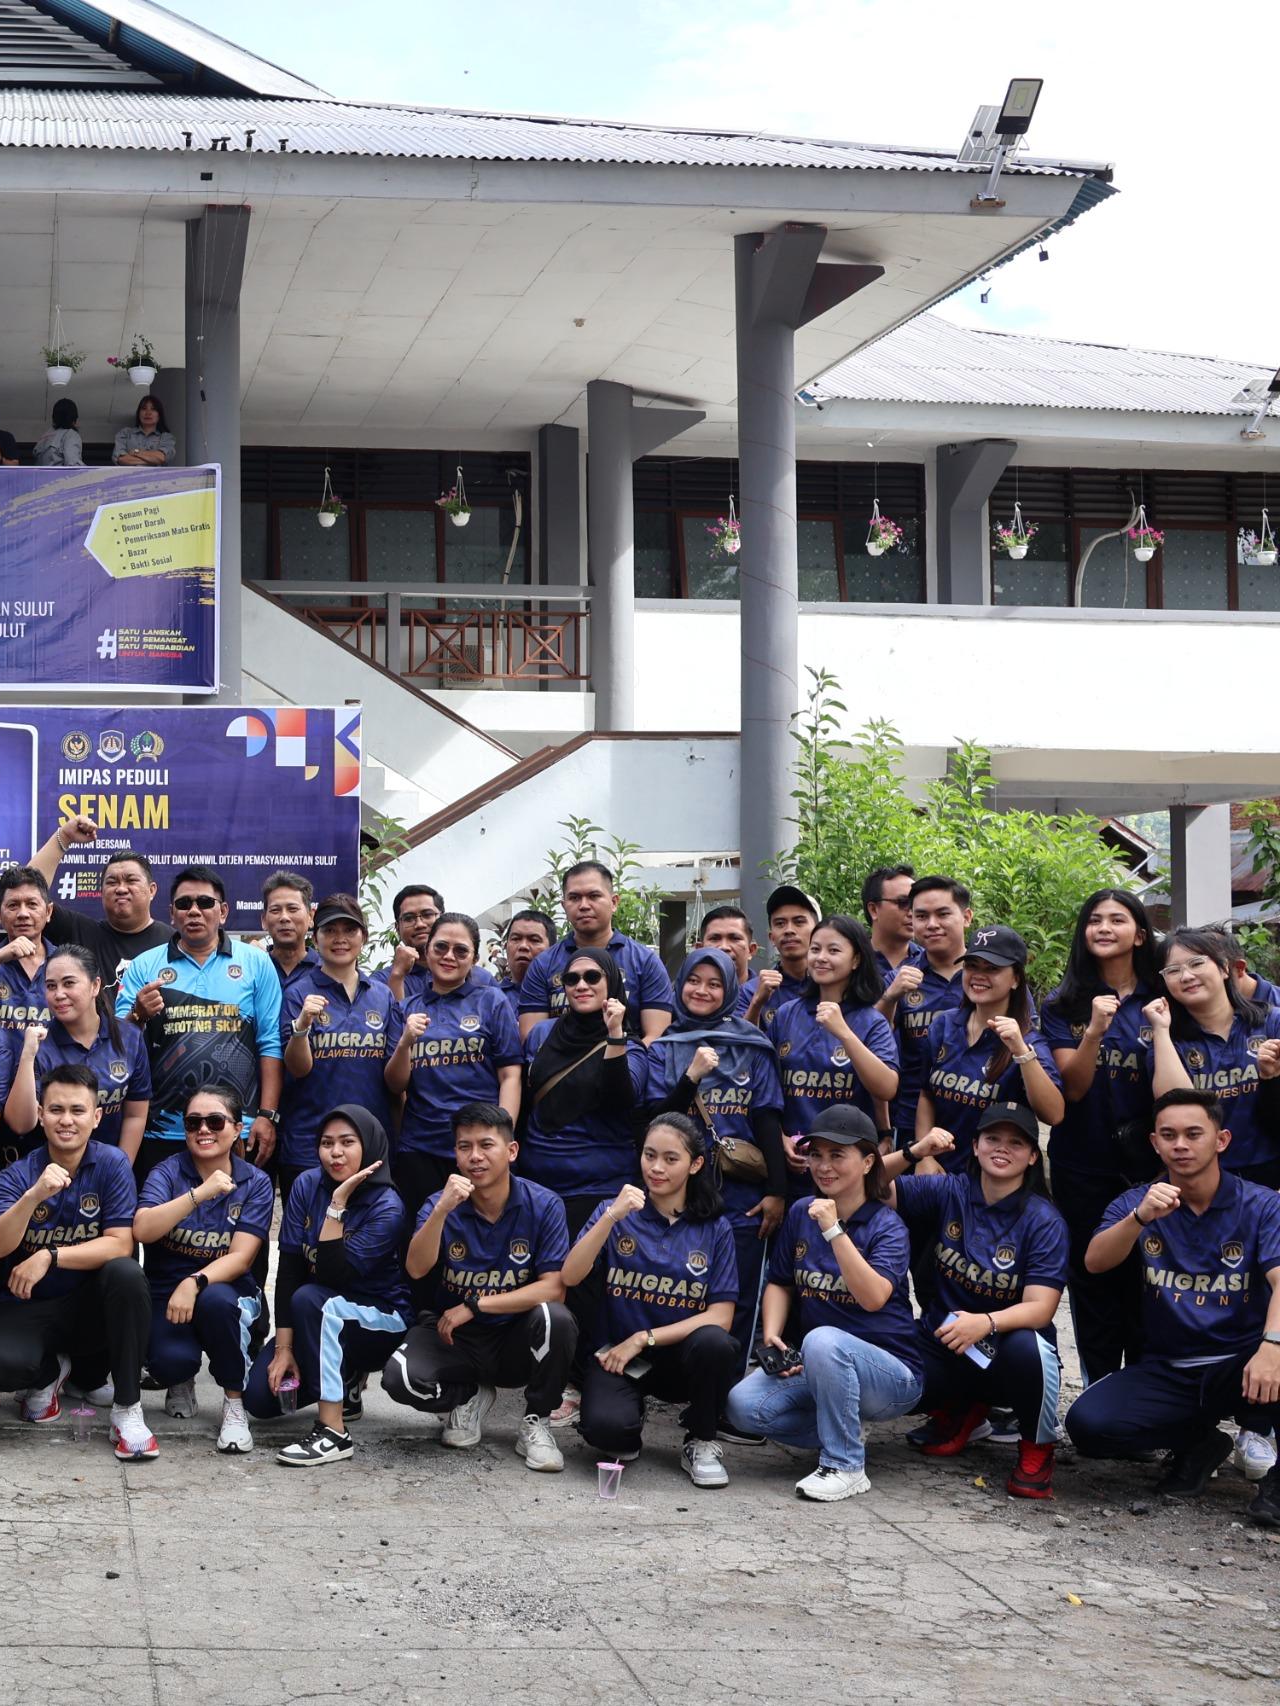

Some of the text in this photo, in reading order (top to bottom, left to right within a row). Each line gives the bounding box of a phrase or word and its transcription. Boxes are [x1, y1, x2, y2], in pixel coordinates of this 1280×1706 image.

[119, 506, 160, 520] Senam Pagi
[122, 518, 165, 532] Donor Darah
[125, 523, 210, 544] Pemeriksaan Mata Gratis
[128, 548, 147, 557] Bazar
[130, 555, 172, 570] Bakti Sosial
[14, 601, 55, 617] SULUT
[142, 643, 195, 651] PENGABDIAN
[59, 768, 169, 785] IMIPAS PEDULI
[58, 793, 169, 830] SENAM
[96, 839, 131, 849] BERSAMA
[149, 855, 171, 865] SULUT
[172, 855, 188, 865] DAN
[189, 855, 217, 865] KANWIL
[219, 855, 243, 865] DITJEN
[244, 855, 313, 865] PEMASYARAKATAN
[314, 856, 337, 866] SULUT
[314, 1049, 384, 1059] ULAWESI UTAR
[410, 1037, 485, 1059] MIGRASI
[410, 1053, 485, 1070] TAMOBAGU
[784, 1070, 853, 1088] IGRASI
[930, 1070, 1000, 1099] IGRASI
[934, 1242, 1019, 1290] MIGRASI
[444, 1267, 529, 1287] IMIGRAS
[607, 1267, 708, 1299] IMIGRASI
[1146, 1266, 1250, 1293] MIGRASI
[1156, 1290, 1249, 1306] ITUNG
